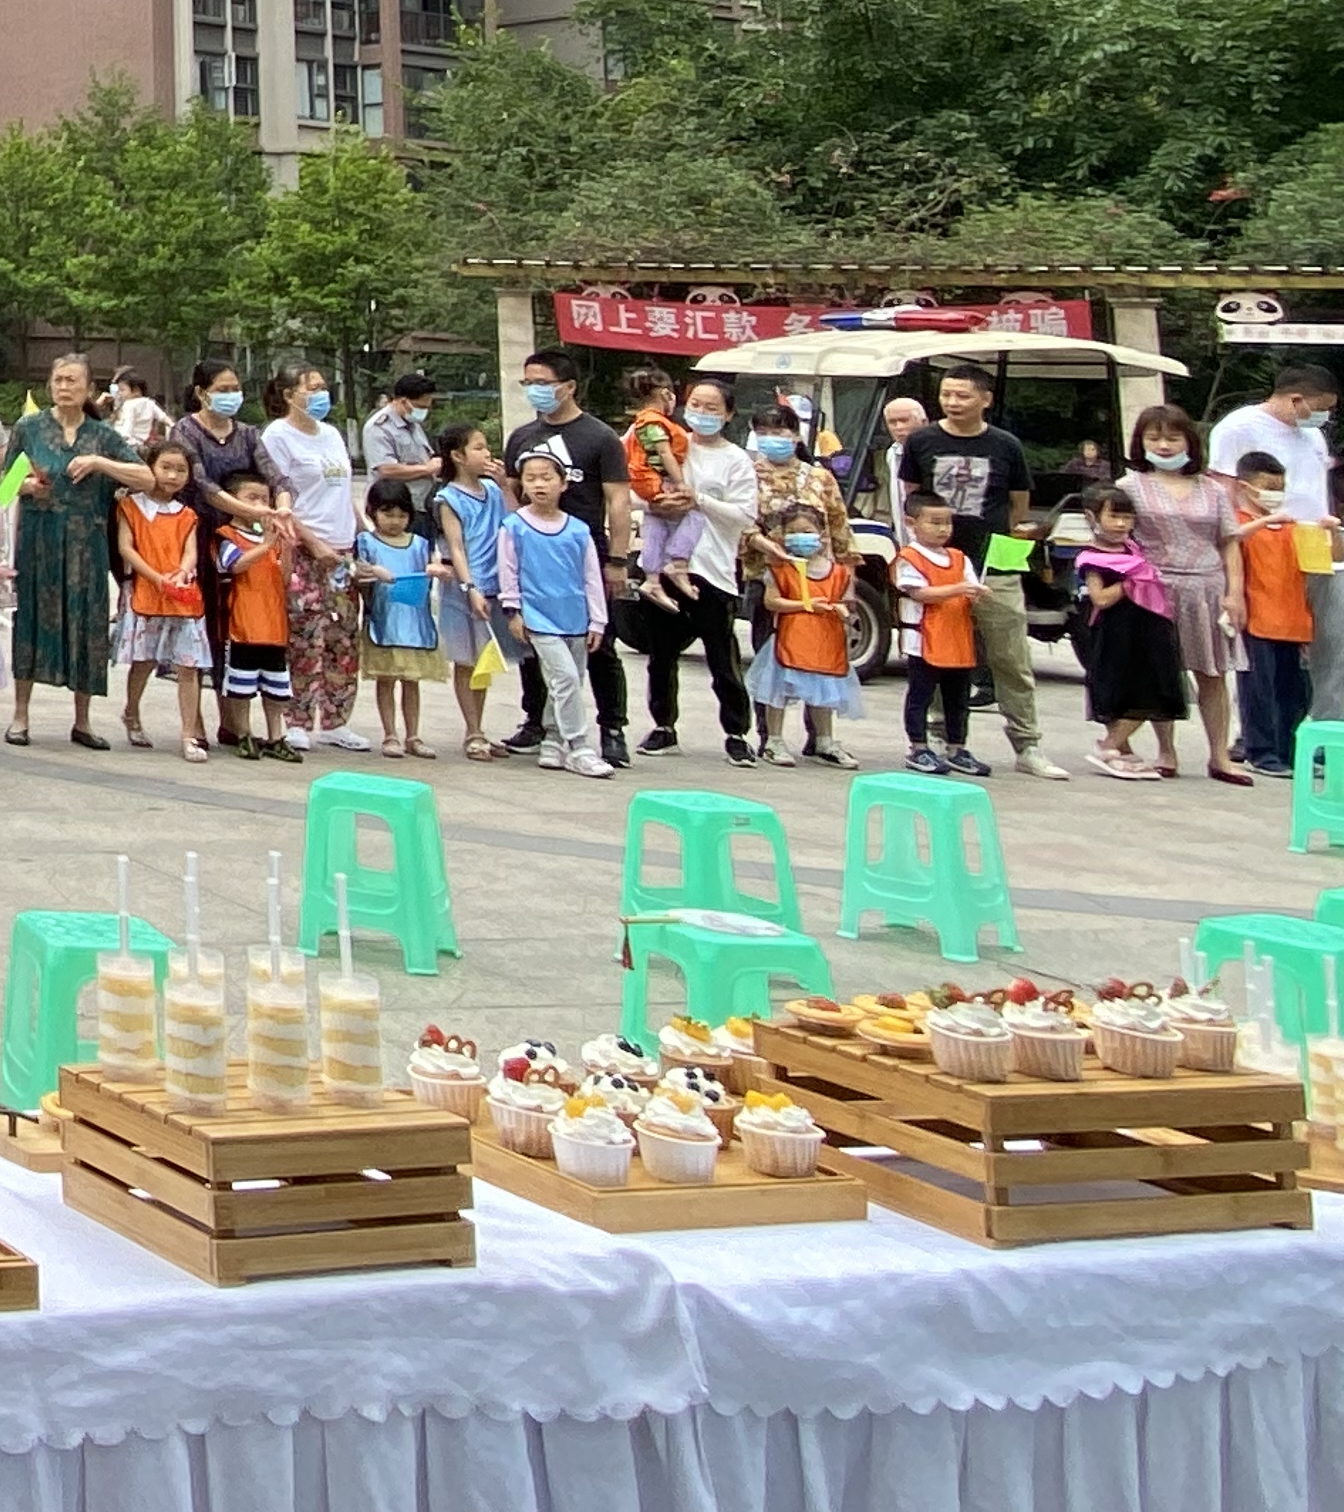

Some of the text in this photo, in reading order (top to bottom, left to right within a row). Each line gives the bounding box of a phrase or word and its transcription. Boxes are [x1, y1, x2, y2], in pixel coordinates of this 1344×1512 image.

[570, 299, 759, 342] 网上要汇款
